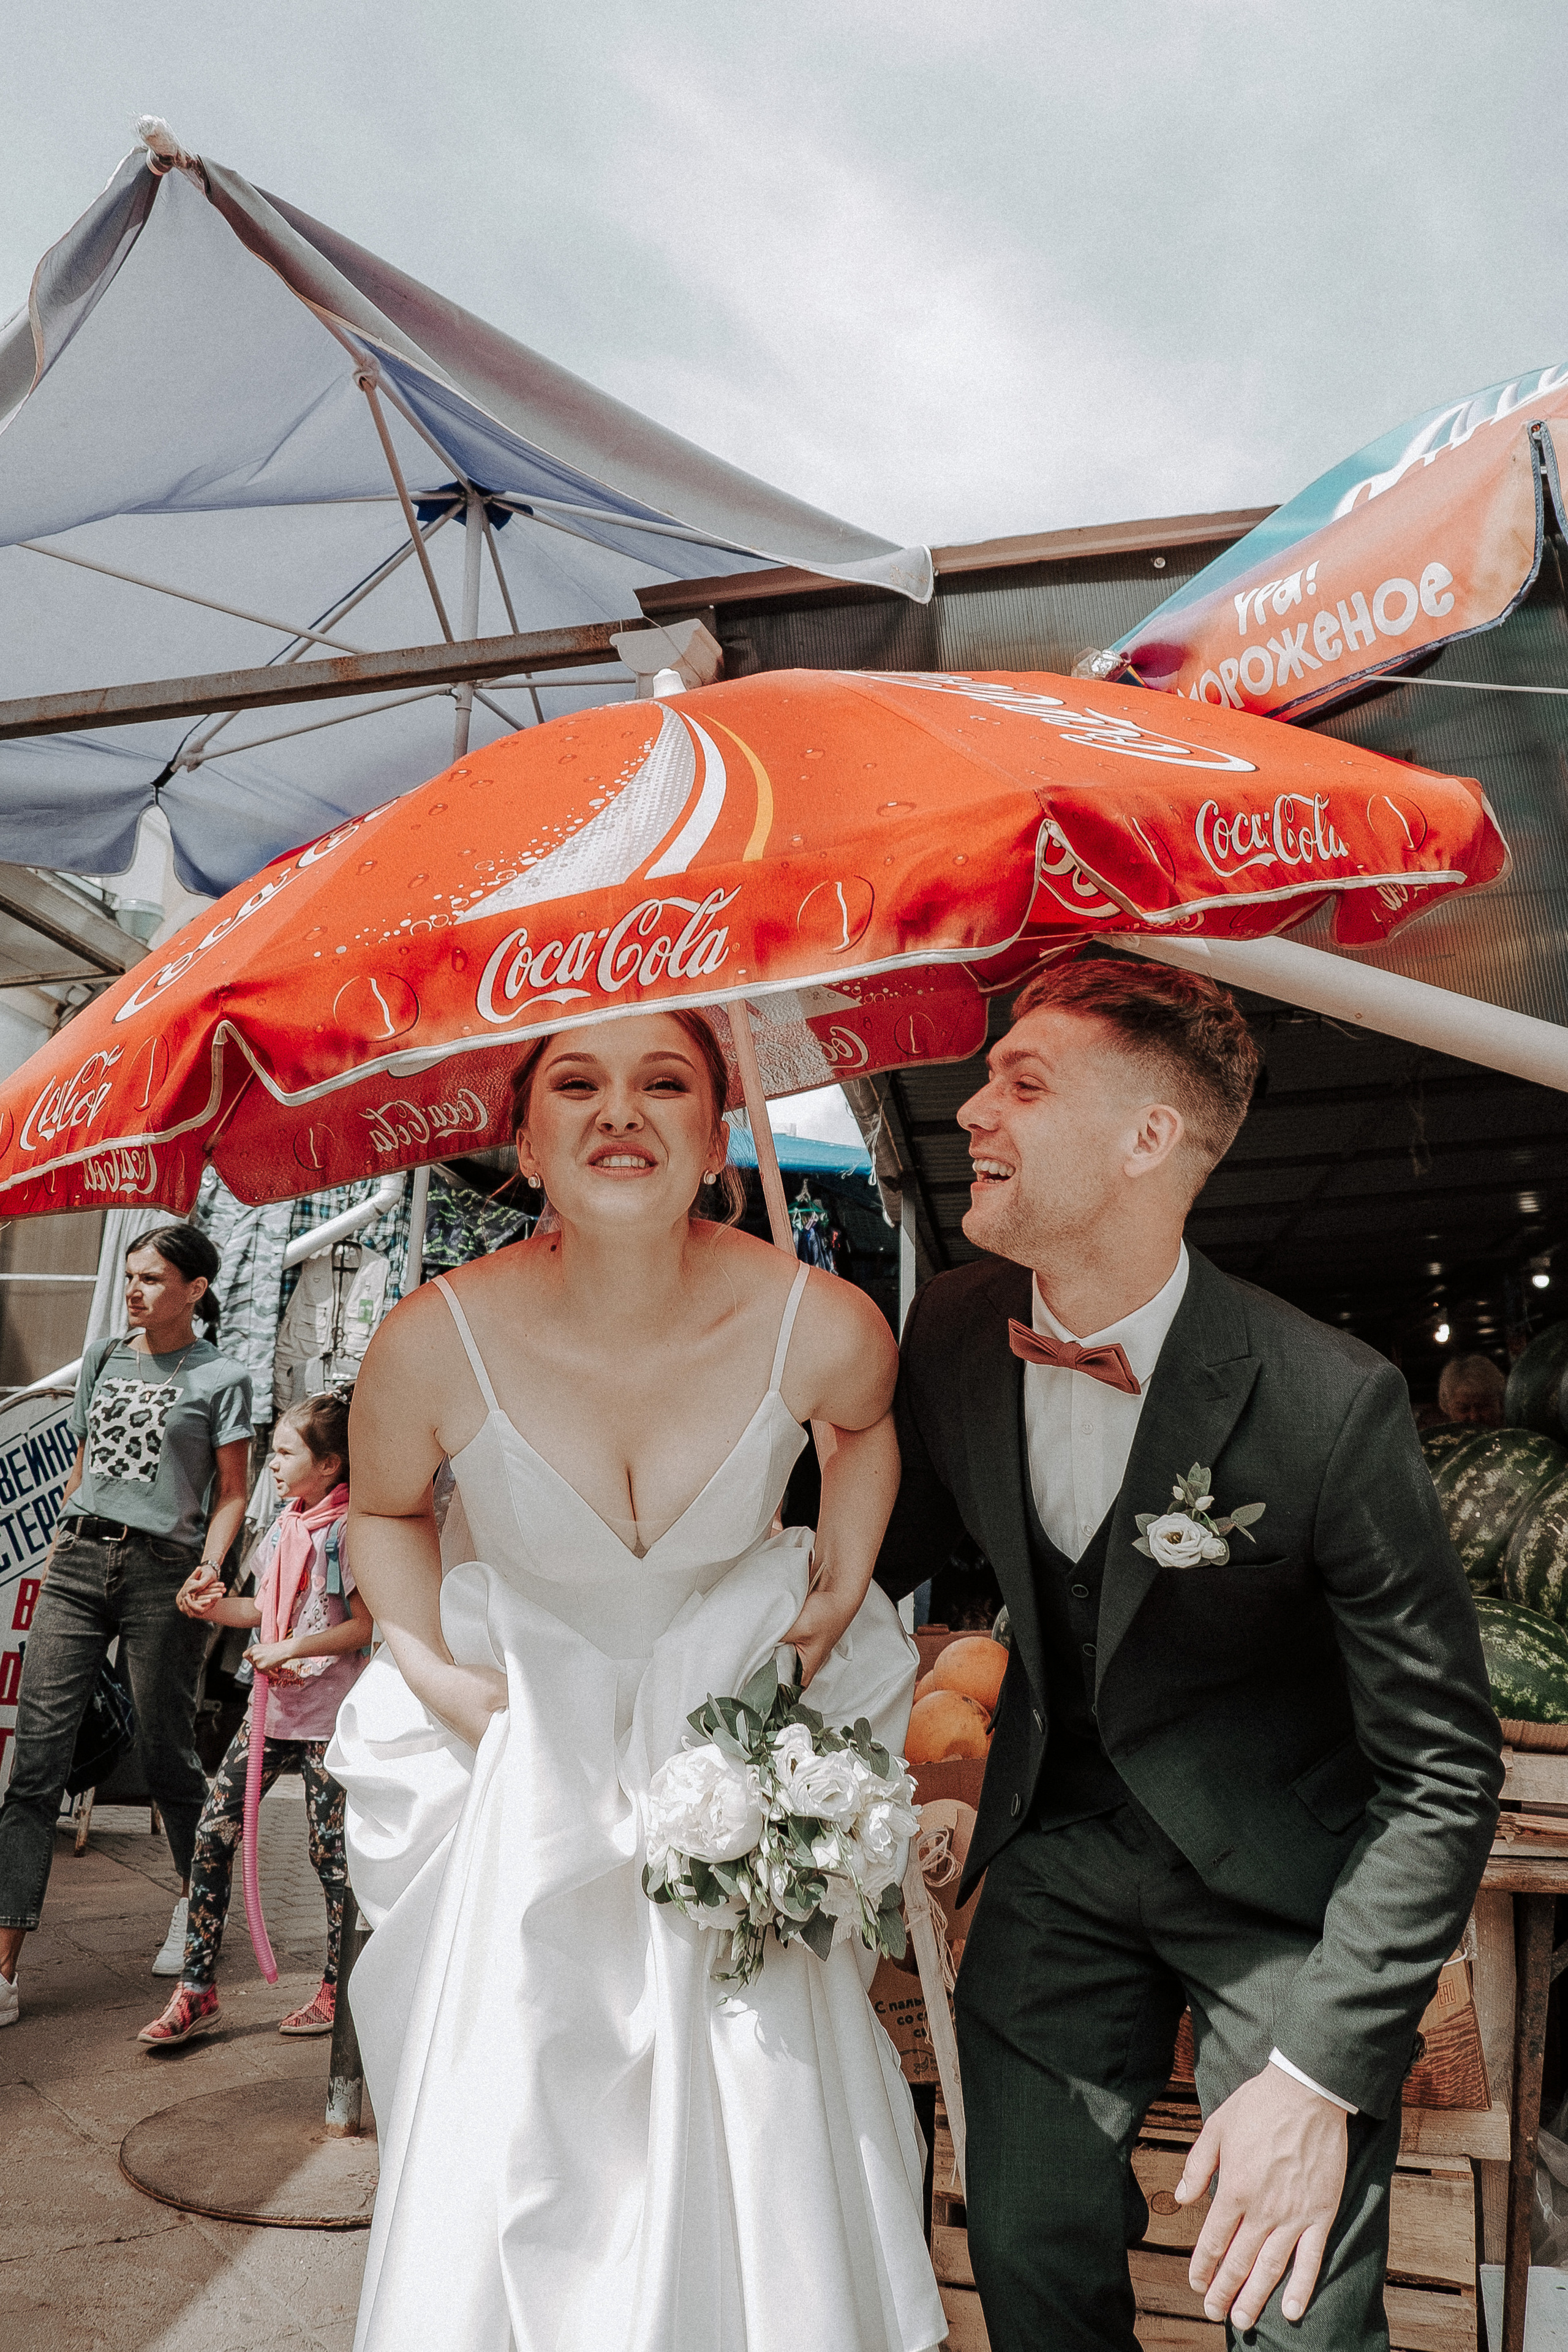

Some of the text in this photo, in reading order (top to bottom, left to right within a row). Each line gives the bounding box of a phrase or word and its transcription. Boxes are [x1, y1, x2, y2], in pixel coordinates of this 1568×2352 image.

[837, 671, 1257, 772] Coca-Co
[1194, 792, 1348, 877] Coca-Cola
[113, 799, 398, 1023] Coca-Co
[477, 884, 742, 1024] Coca-Cola
[889, 1996, 925, 2012] паль
